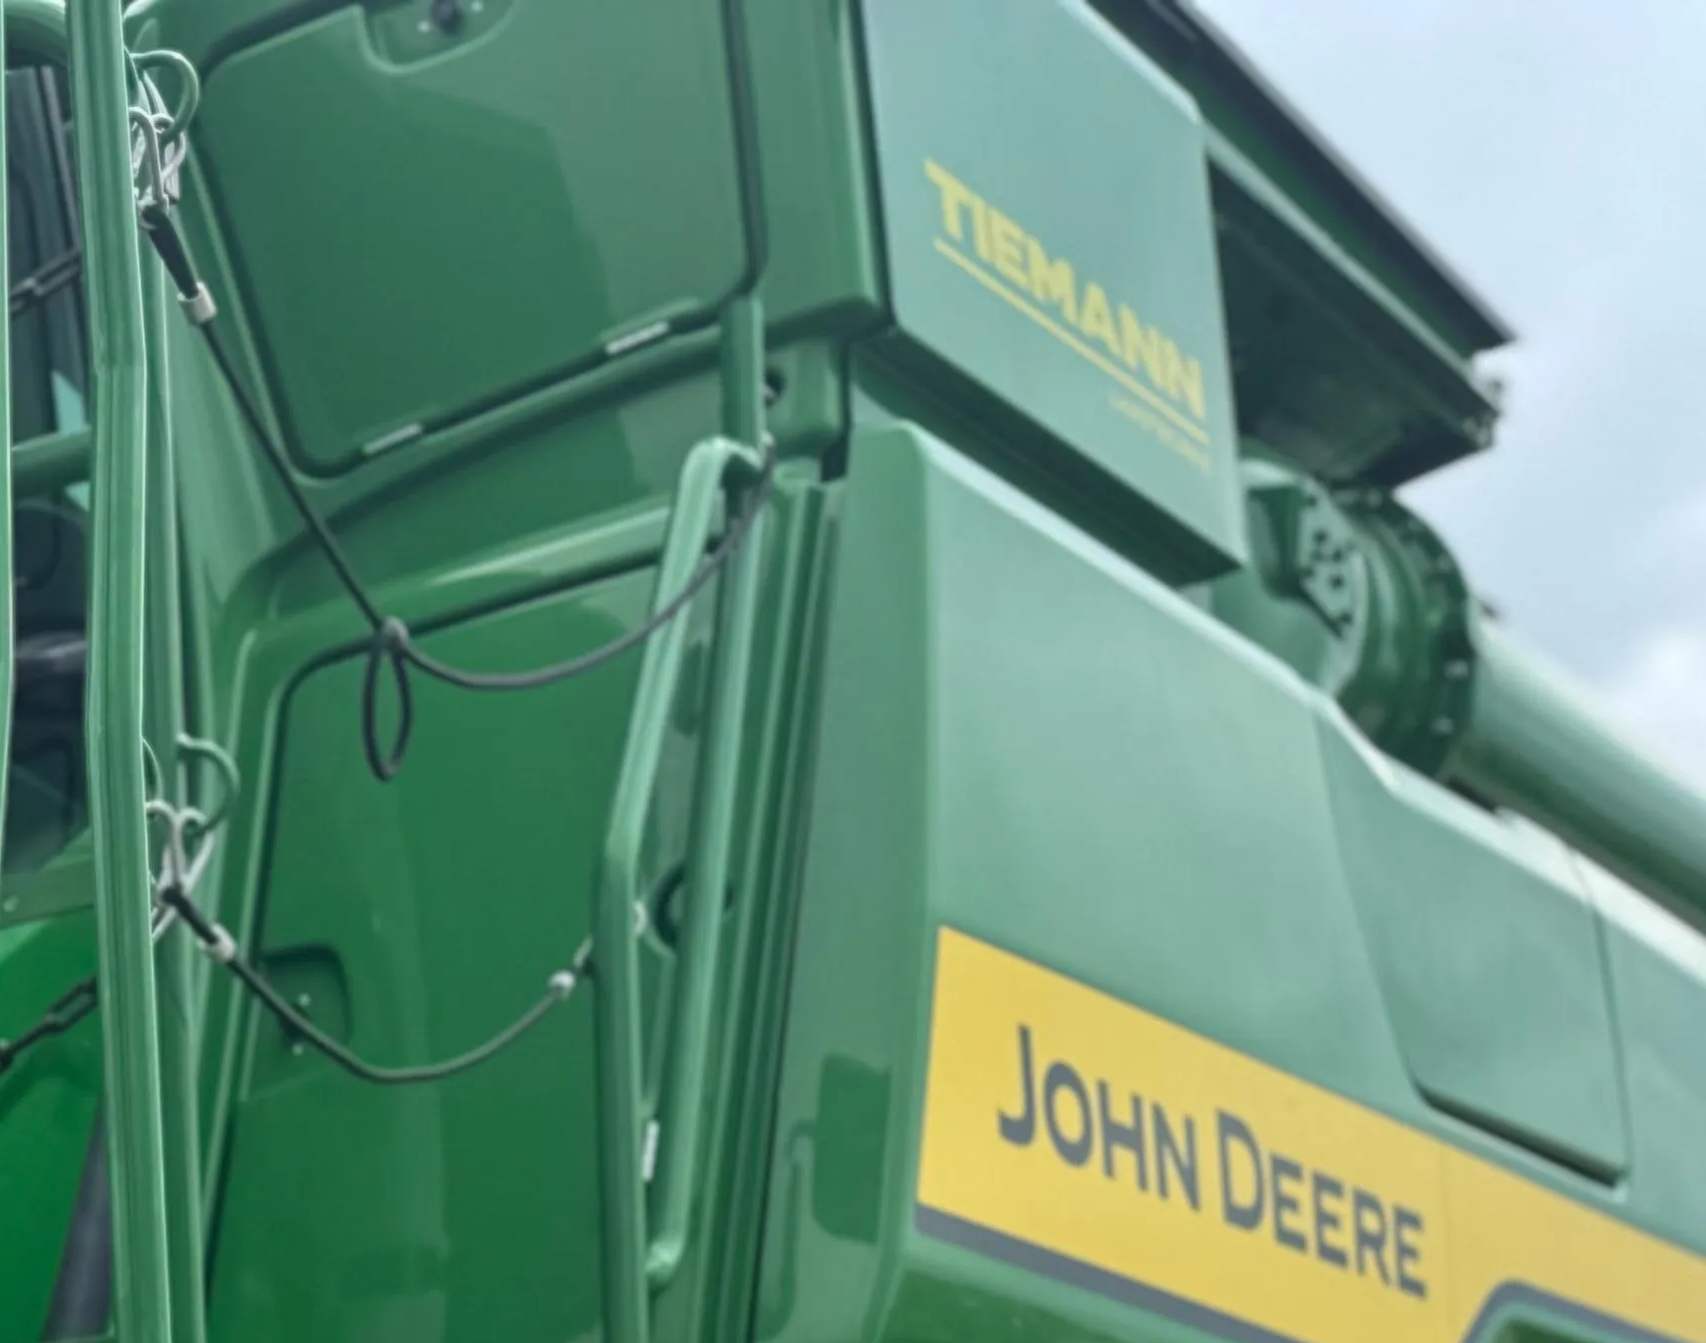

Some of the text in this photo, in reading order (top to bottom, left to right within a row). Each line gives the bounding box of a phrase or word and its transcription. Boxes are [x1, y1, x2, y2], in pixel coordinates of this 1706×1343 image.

[923, 156, 1206, 420] TIEMANN
[996, 1024, 1429, 1299] JOHN DEERE
